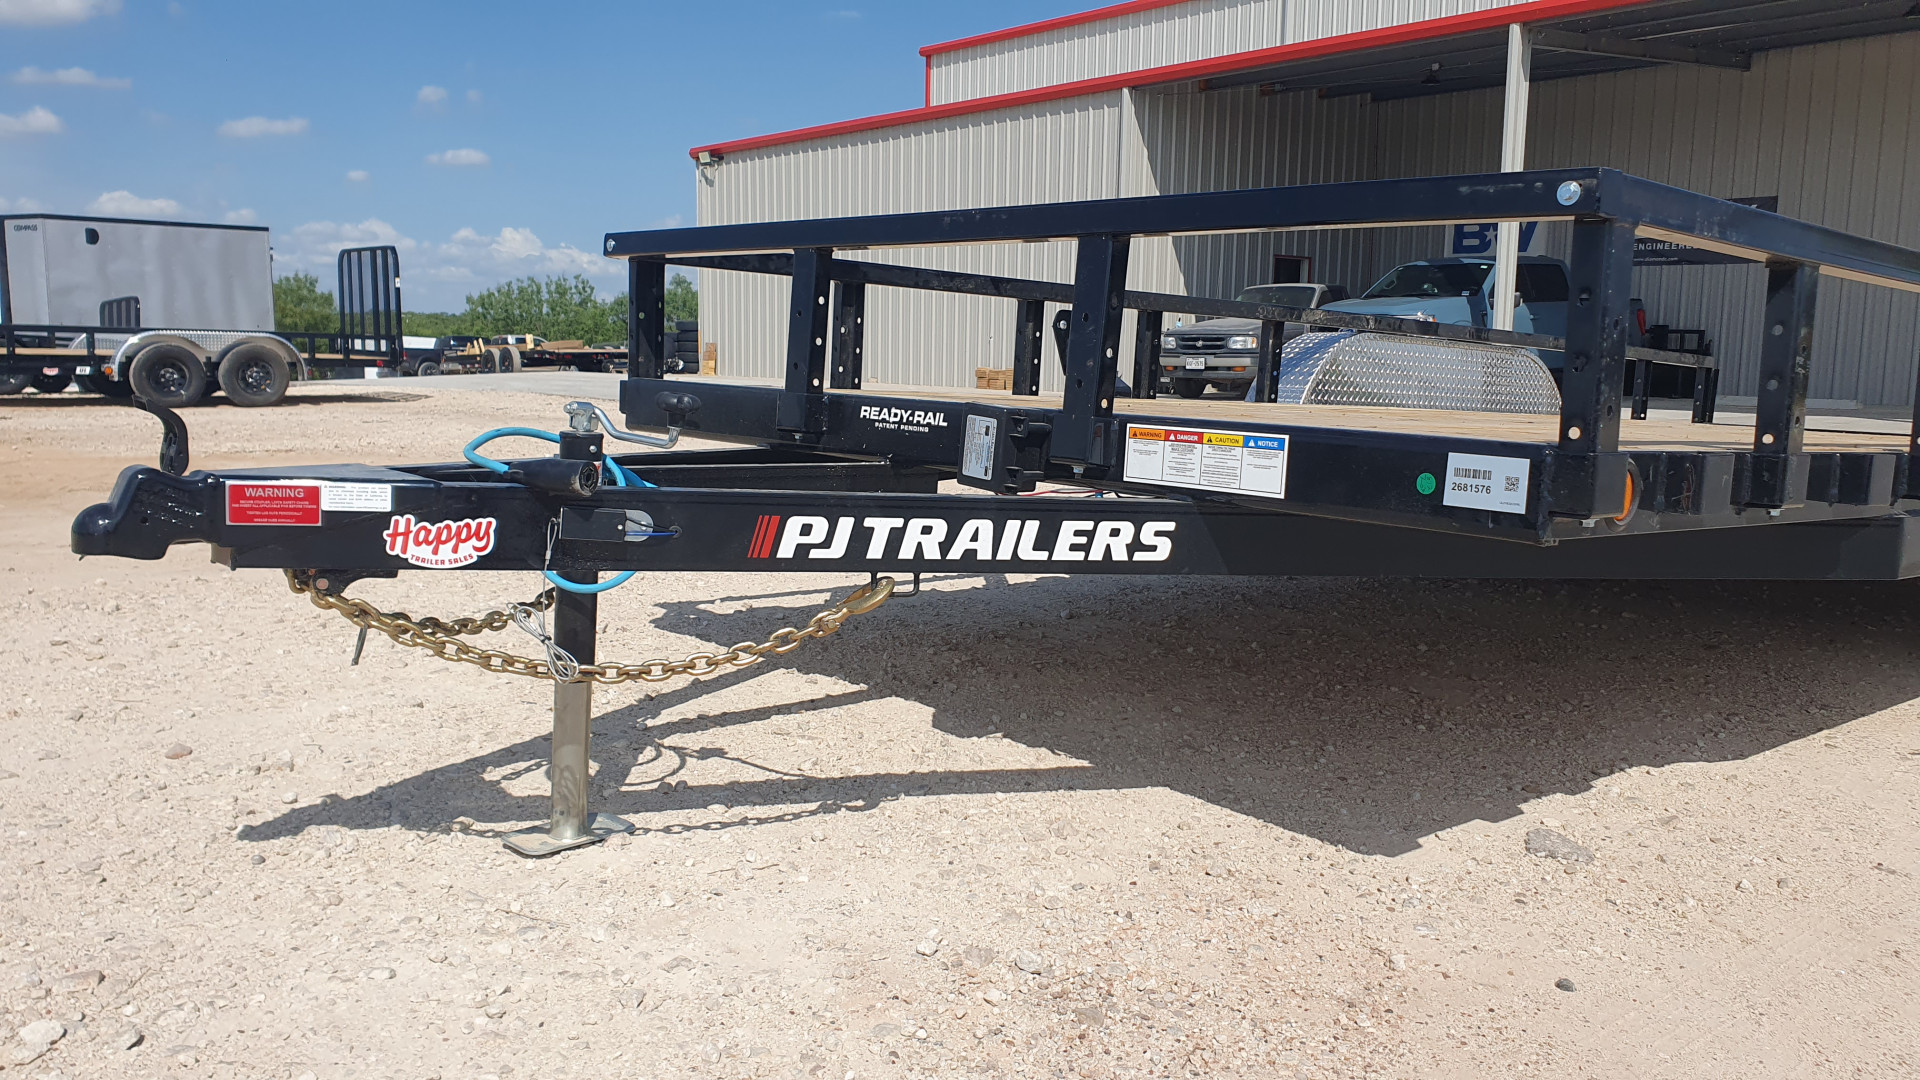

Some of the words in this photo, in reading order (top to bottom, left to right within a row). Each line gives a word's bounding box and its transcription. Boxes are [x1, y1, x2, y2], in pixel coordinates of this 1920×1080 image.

[859, 405, 948, 427] READY-RAIL
[874, 421, 899, 430] PATENT
[900, 424, 929, 433] PENDING
[1176, 433, 1199, 441] DANGER
[1215, 436, 1240, 444] CAUTION
[1257, 440, 1279, 448] NOTICE
[244, 487, 304, 498] WARNING
[1451, 482, 1492, 495] 2681576
[385, 517, 493, 556] Happy
[775, 515, 856, 559] PJ
[863, 516, 1177, 562] TRAILERS
[410, 553, 446, 566] TRAILER
[448, 553, 474, 565] SALES
